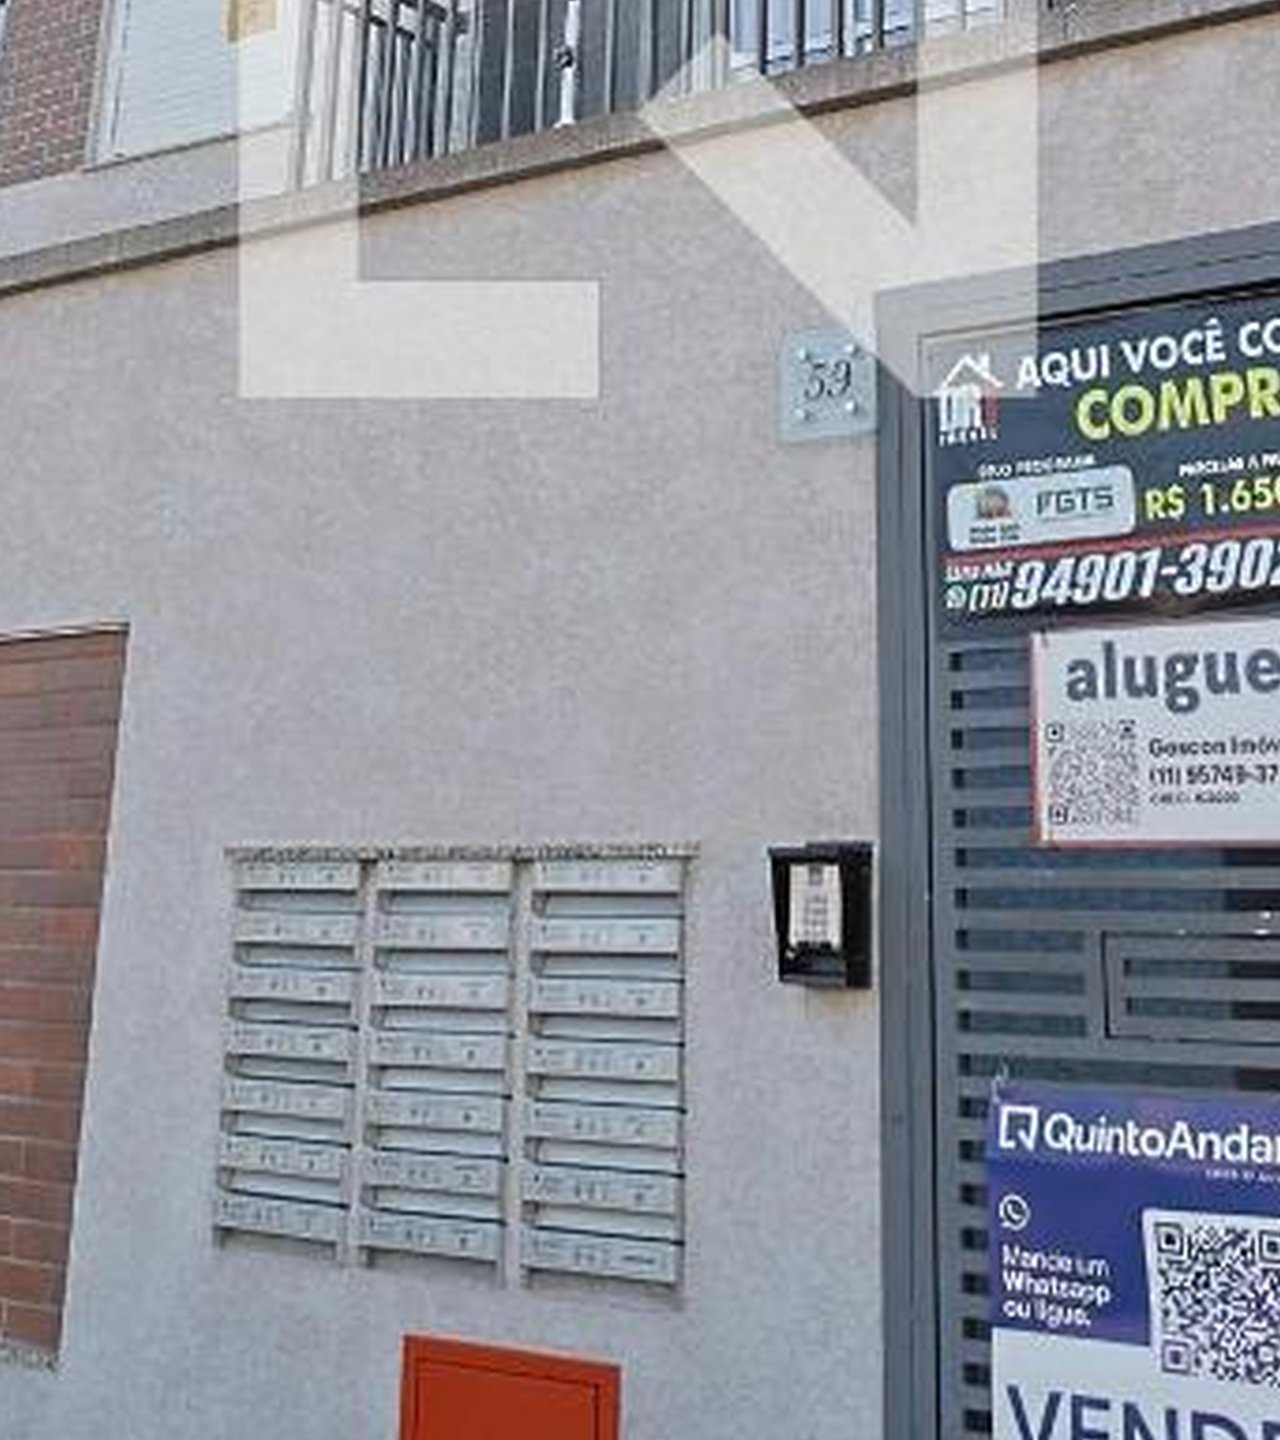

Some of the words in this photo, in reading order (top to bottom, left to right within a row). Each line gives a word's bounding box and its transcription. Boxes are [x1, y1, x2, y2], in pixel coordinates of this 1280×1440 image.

[1017, 345, 1110, 389] AQUI
[1123, 318, 1225, 372] VOCÊ
[1035, 485, 1114, 515] FGTS
[1144, 482, 1185, 521] R$
[1149, 766, 1182, 786] (11)
[1002, 1243, 1071, 1273] Mande
[1075, 1257, 1110, 1277] um
[1002, 1299, 1031, 1319] ou
